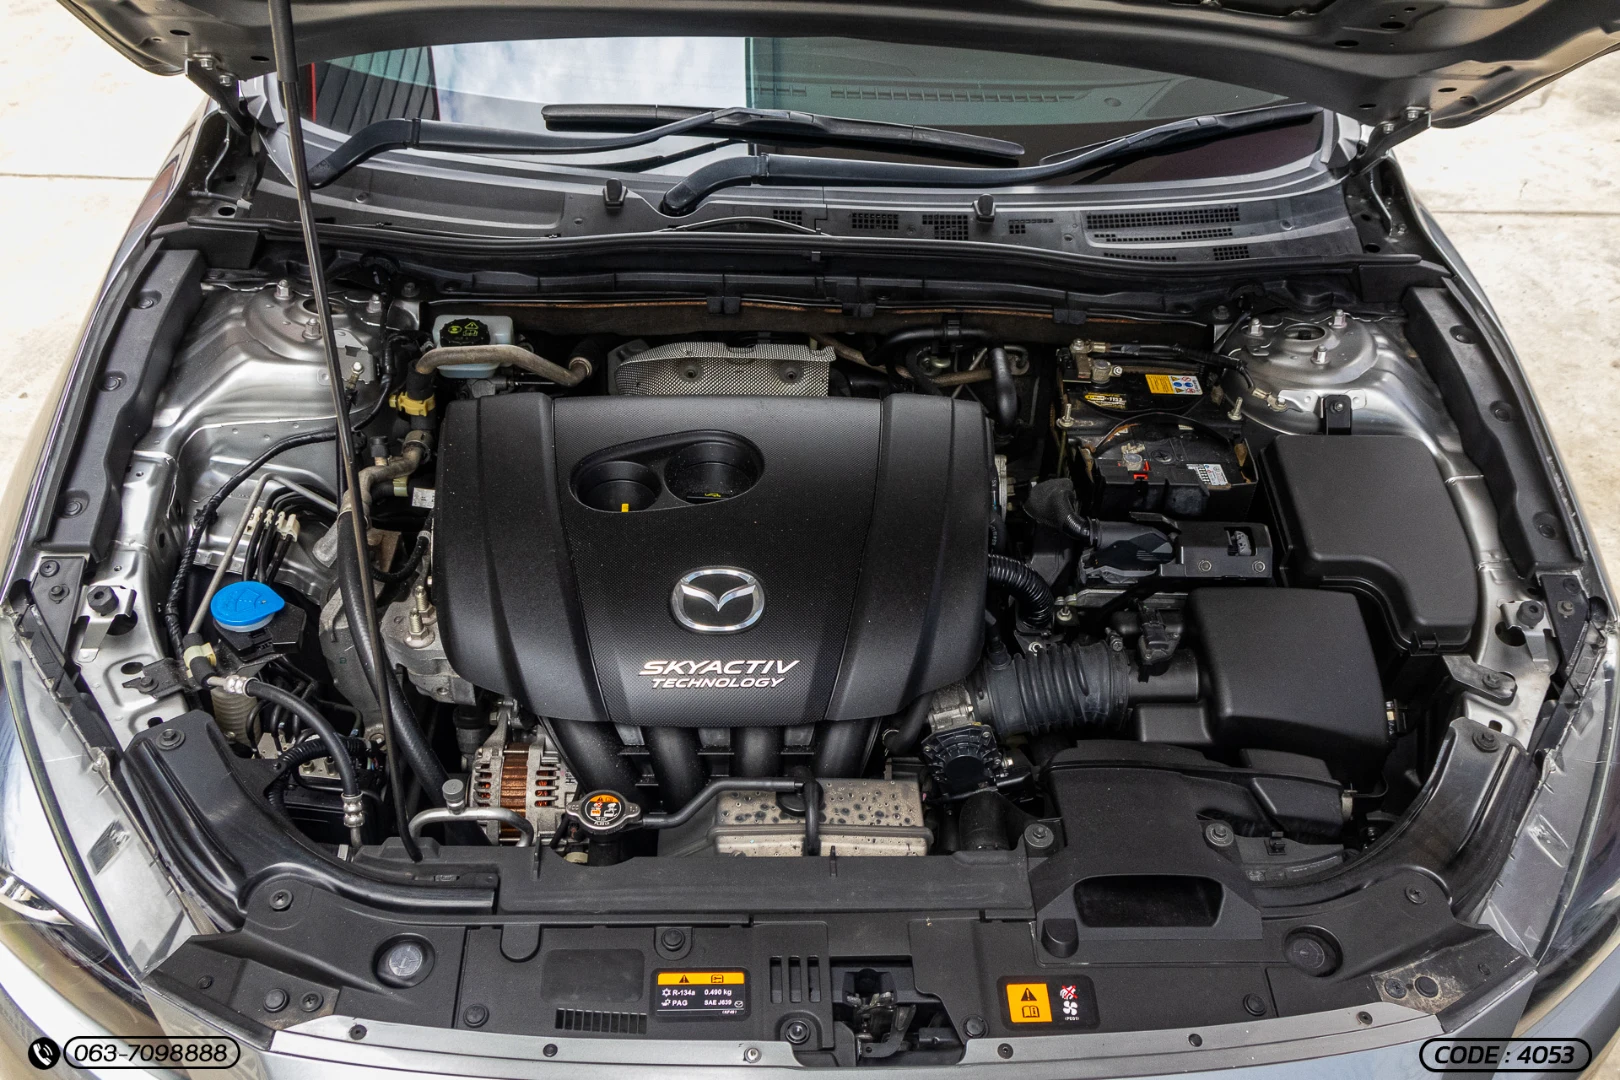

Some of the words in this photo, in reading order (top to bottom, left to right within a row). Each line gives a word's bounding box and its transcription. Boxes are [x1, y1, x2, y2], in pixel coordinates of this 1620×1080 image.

[638, 660, 800, 675] SKYACTIV
[652, 678, 785, 688] TECHNOLOGY
[723, 988, 732, 997] kg
[672, 999, 688, 1007] PAG
